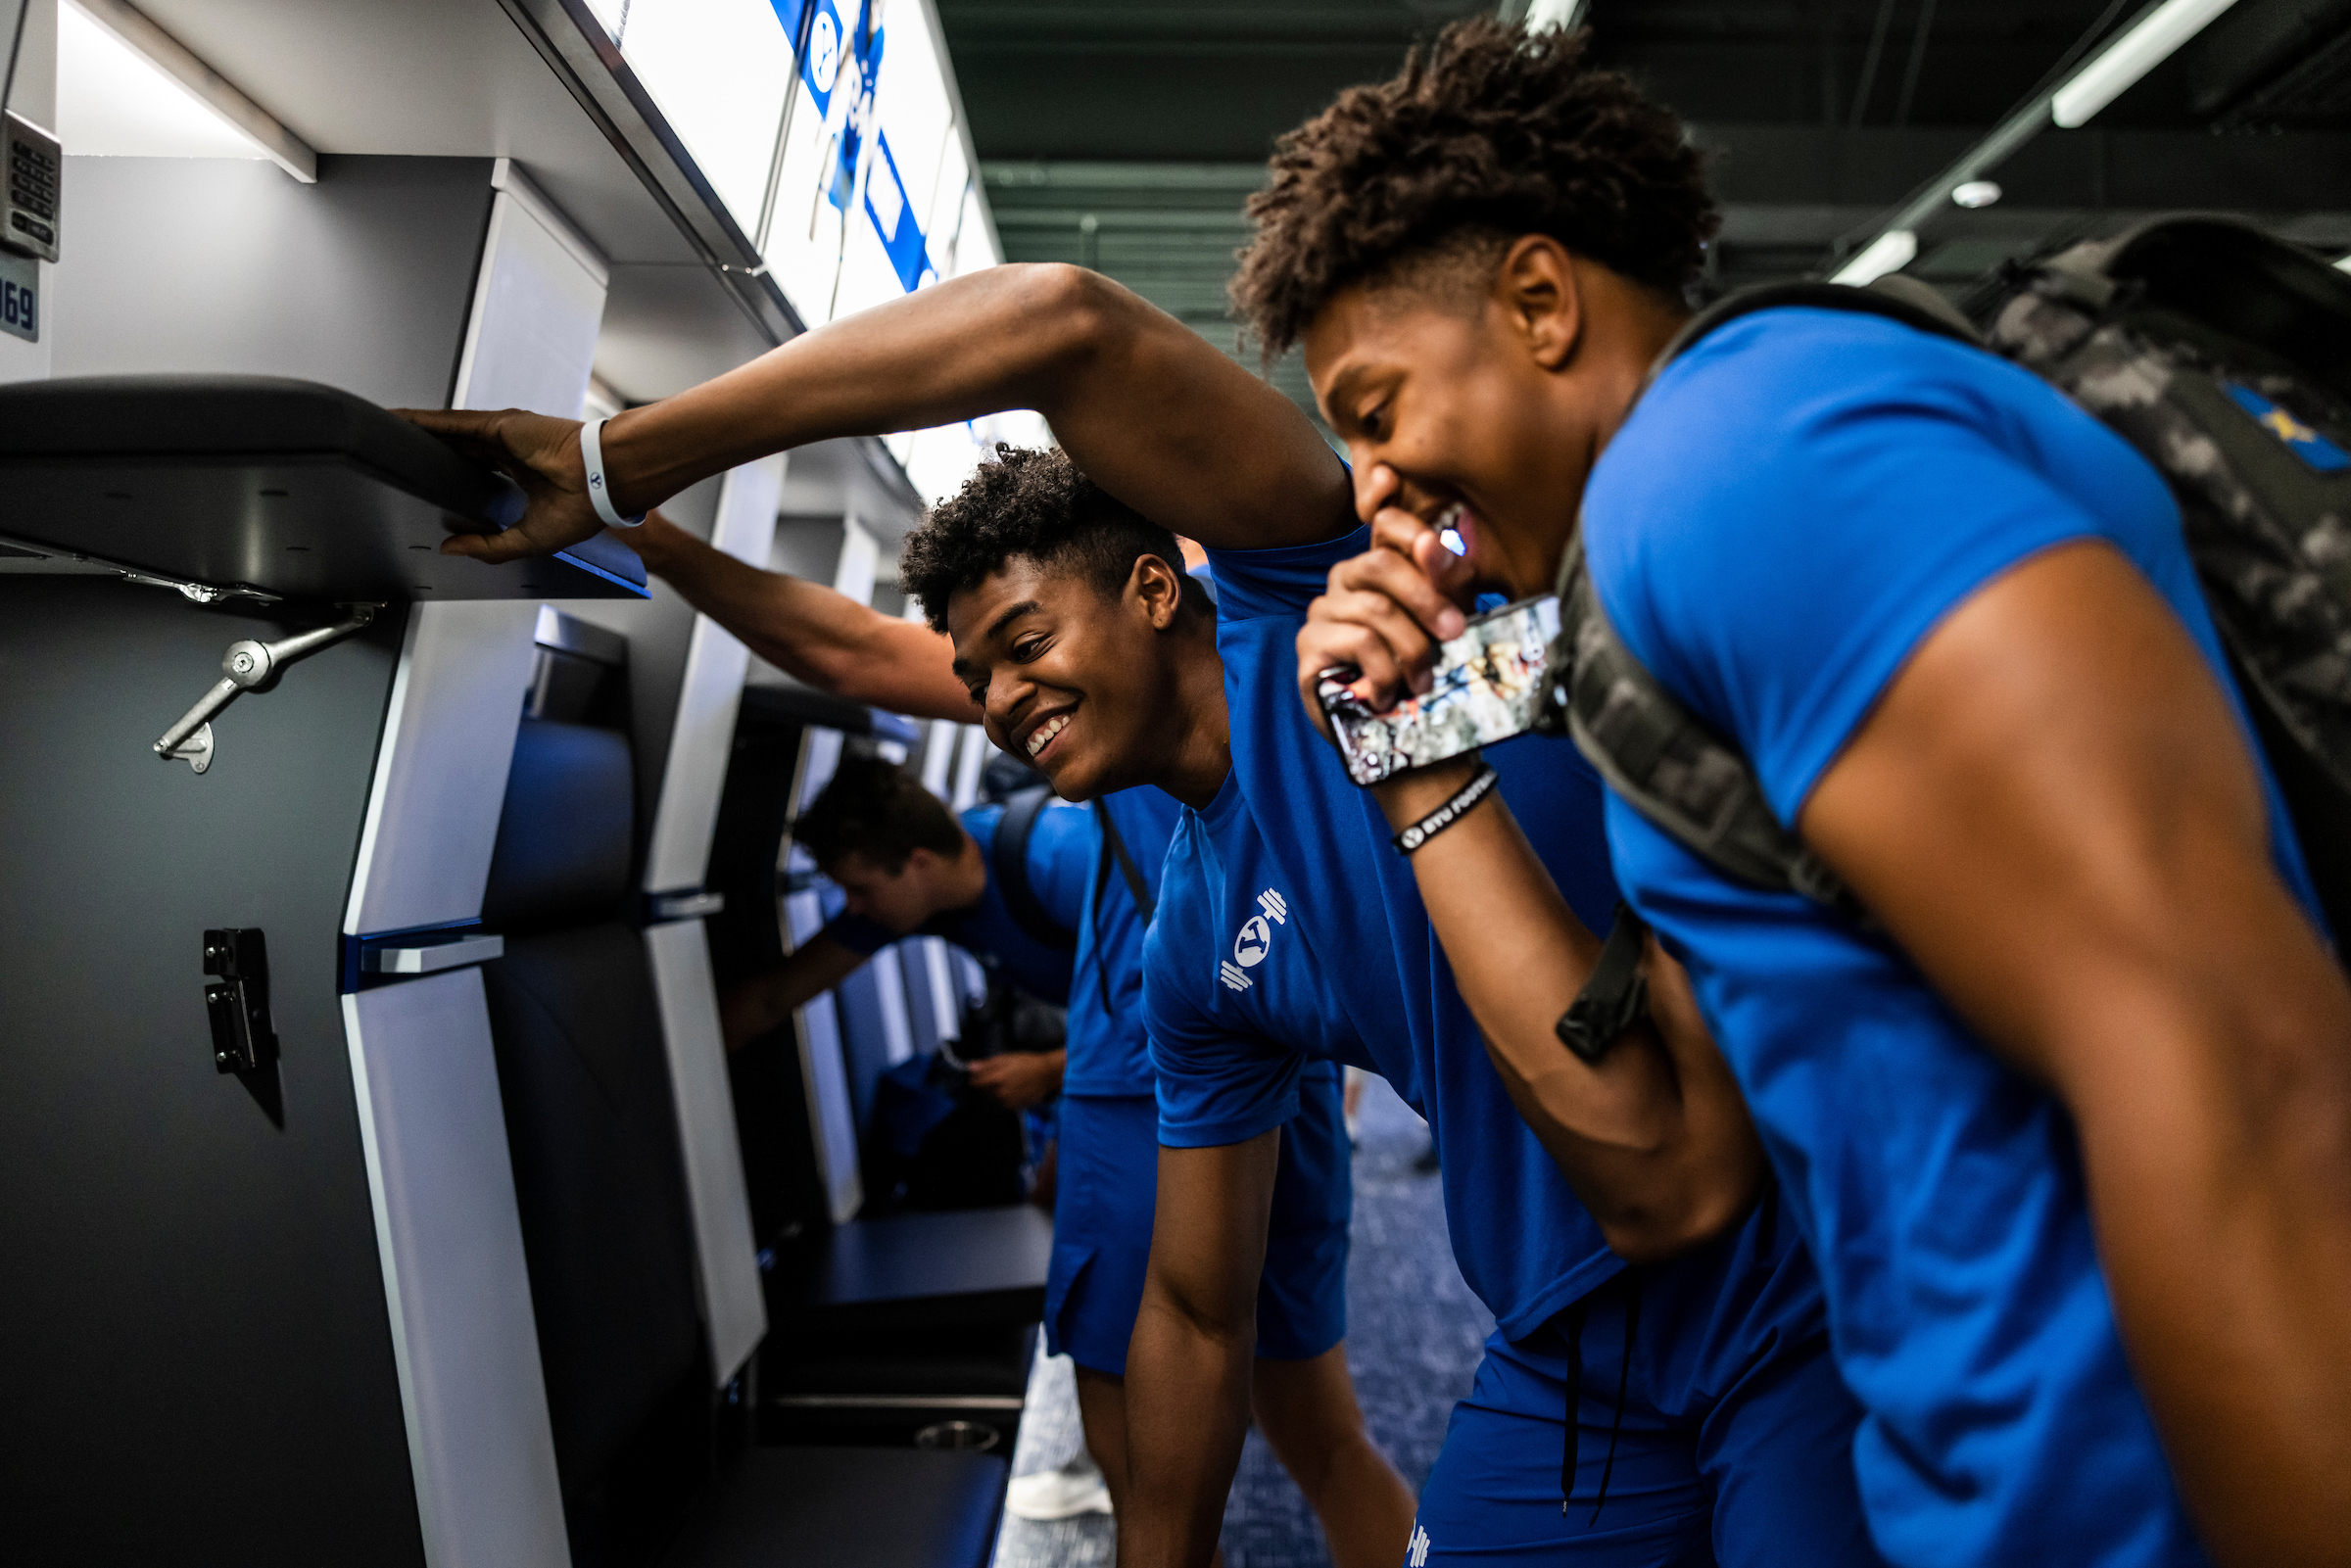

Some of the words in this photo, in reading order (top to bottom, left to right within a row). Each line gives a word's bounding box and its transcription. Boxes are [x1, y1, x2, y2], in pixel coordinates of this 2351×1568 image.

[0, 278, 33, 331] 69
[1421, 807, 1453, 834] BYU
[1237, 920, 1268, 956] Y
